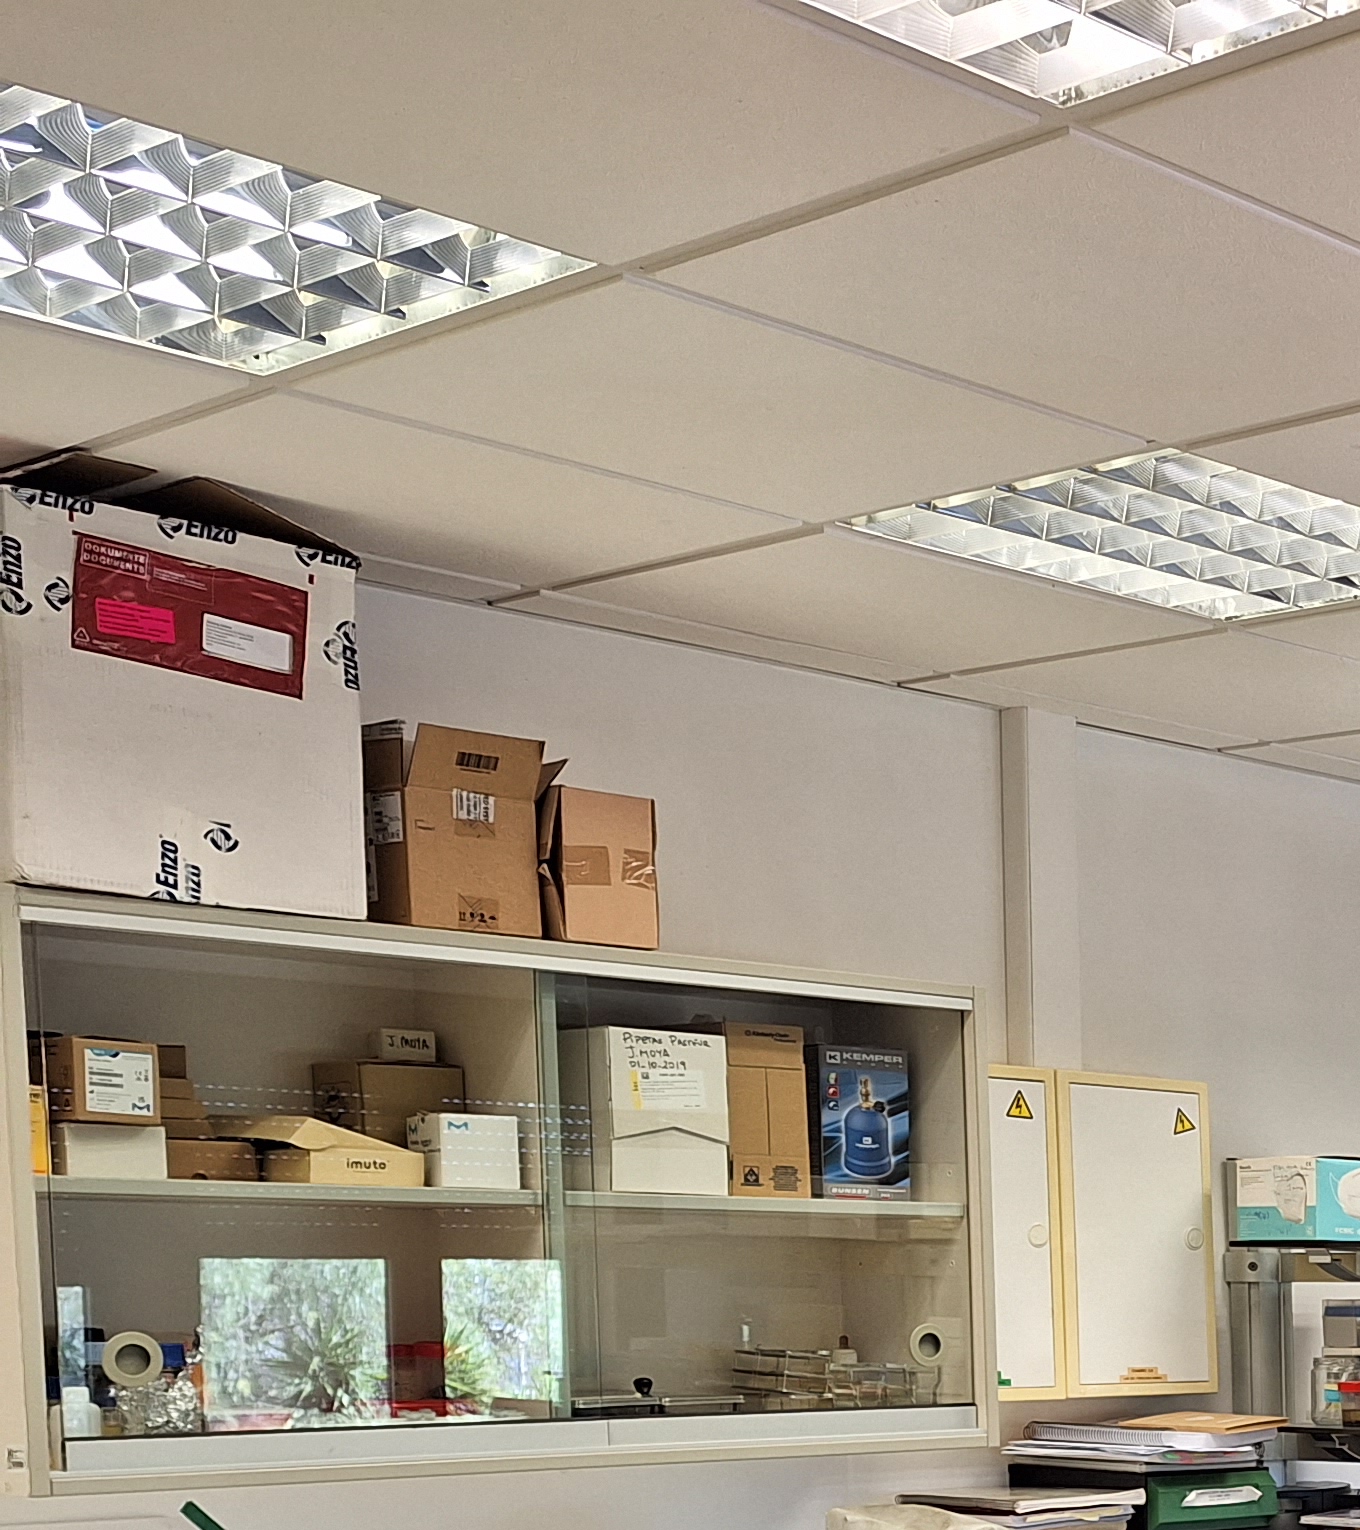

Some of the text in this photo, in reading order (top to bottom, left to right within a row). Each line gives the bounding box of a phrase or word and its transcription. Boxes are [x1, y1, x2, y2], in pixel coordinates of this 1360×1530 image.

[185, 520, 237, 545] Enzo
[156, 839, 179, 891] Enzo
[184, 863, 202, 901] nzo
[842, 1051, 903, 1064] KEMPER
[346, 1157, 387, 1171] imuto
